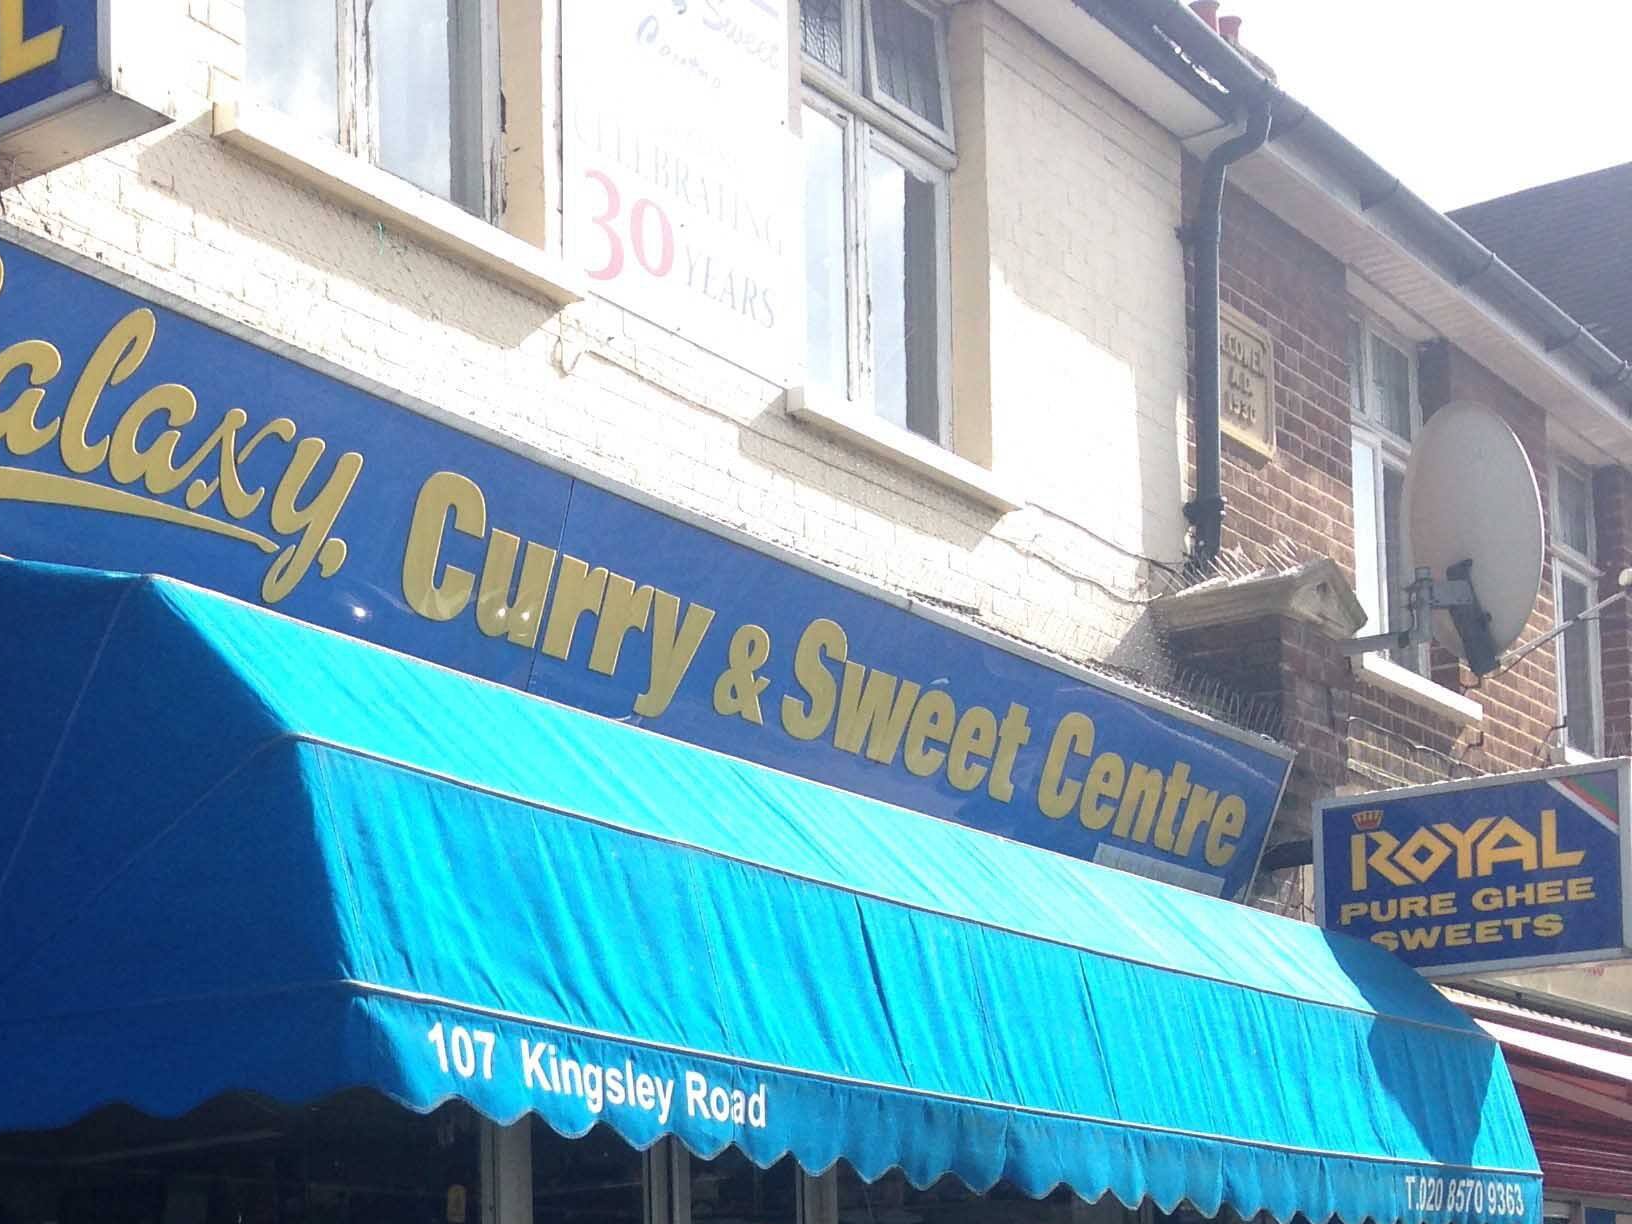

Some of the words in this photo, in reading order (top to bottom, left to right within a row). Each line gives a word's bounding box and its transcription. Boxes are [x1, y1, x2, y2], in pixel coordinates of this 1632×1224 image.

[583, 168, 675, 281] 30
[402, 472, 716, 717] Curry
[714, 624, 770, 725] &
[781, 618, 1030, 803] Sweet
[1037, 712, 1247, 867] Centre
[1351, 810, 1585, 891] ROYAL
[1339, 892, 1457, 926] PURE
[1471, 877, 1596, 911] GHEE
[1370, 913, 1564, 952] SWEETS
[428, 1023, 497, 1080] 107
[521, 1039, 675, 1124] Kingsley
[686, 1071, 767, 1128] Road
[1405, 1176, 1444, 1211] T.020
[1447, 1178, 1483, 1214] 8570
[1488, 1183, 1525, 1216] 9363
